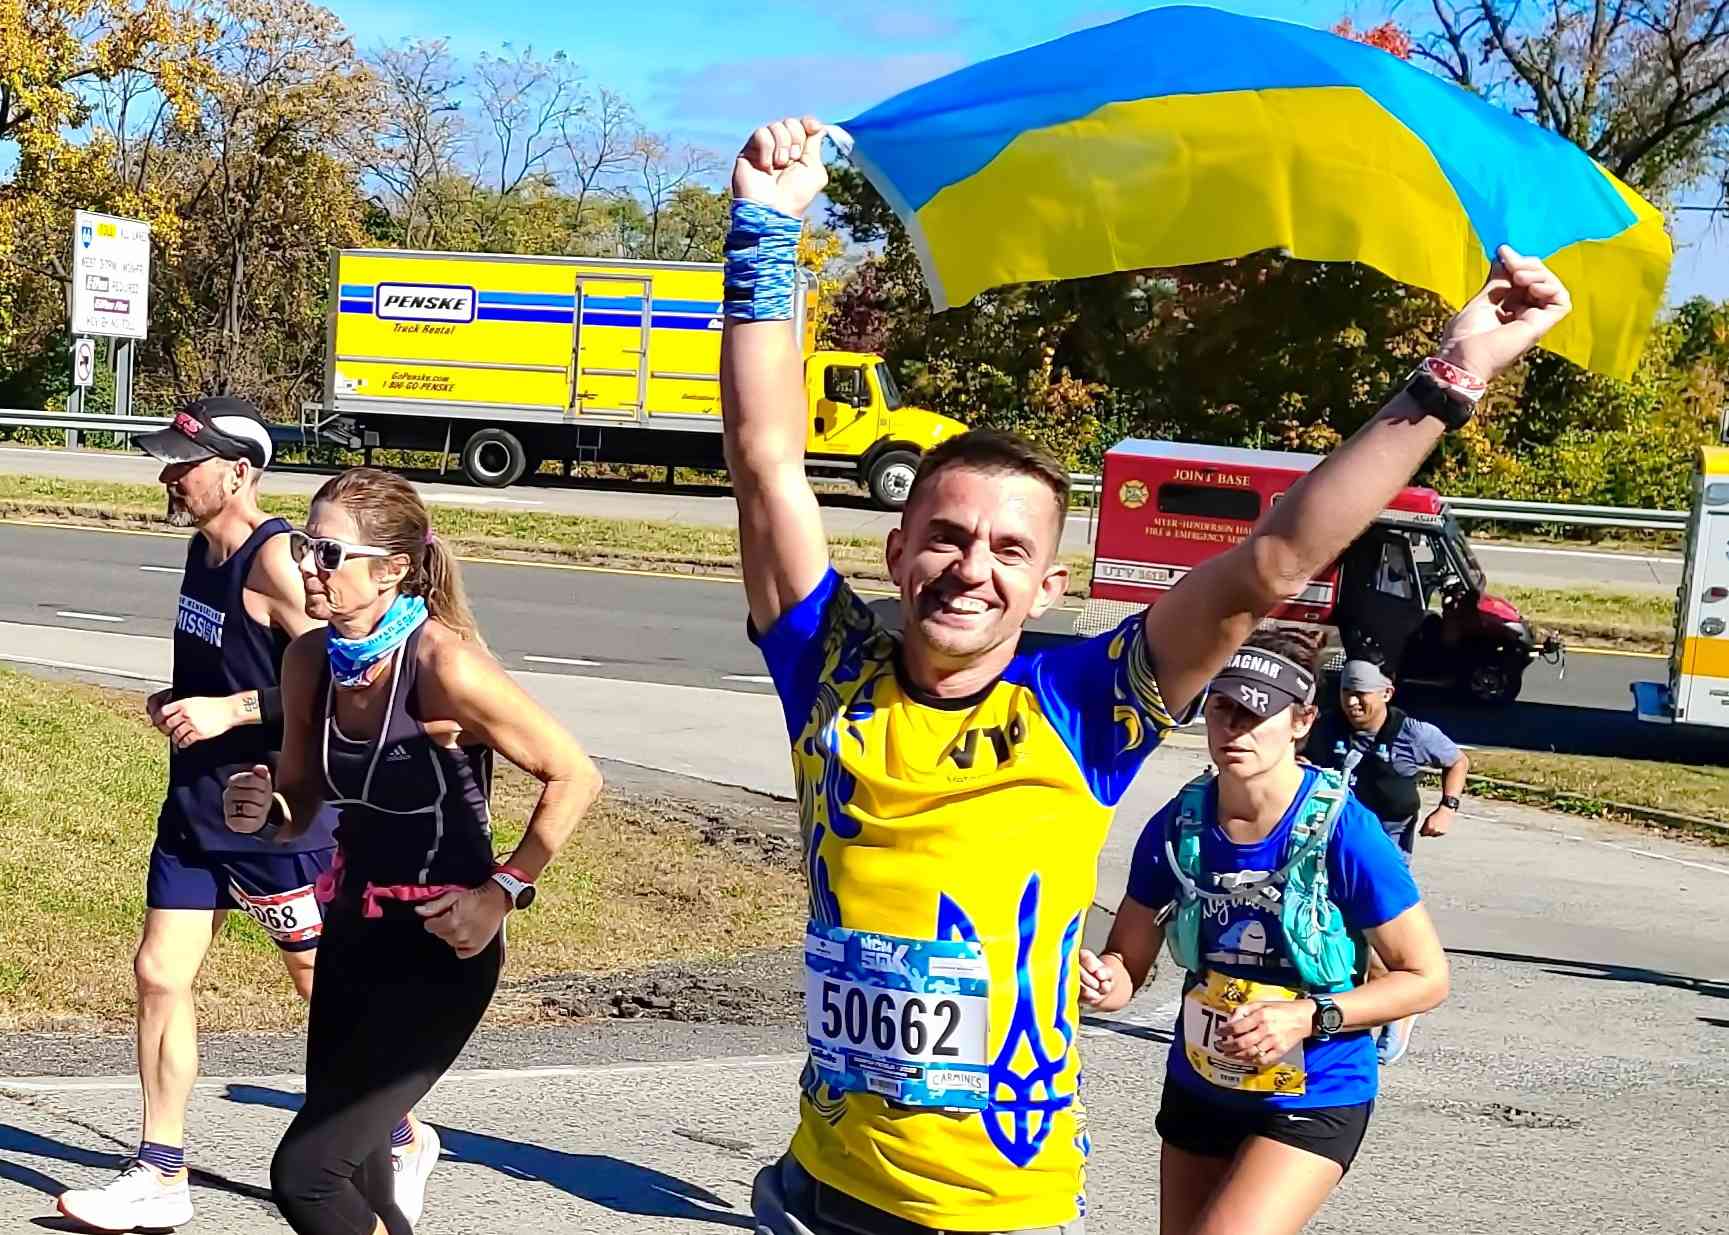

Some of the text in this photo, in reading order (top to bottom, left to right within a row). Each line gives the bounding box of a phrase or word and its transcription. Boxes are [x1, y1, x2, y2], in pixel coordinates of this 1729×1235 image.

[384, 295, 468, 311] PENSKE
[393, 322, 456, 336] Truck Rental
[1173, 468, 1250, 487] JOINT BASE
[1174, 529, 1225, 543] EMERGENCY
[821, 981, 960, 1057] 50662
[932, 1072, 982, 1089] CARMINES
